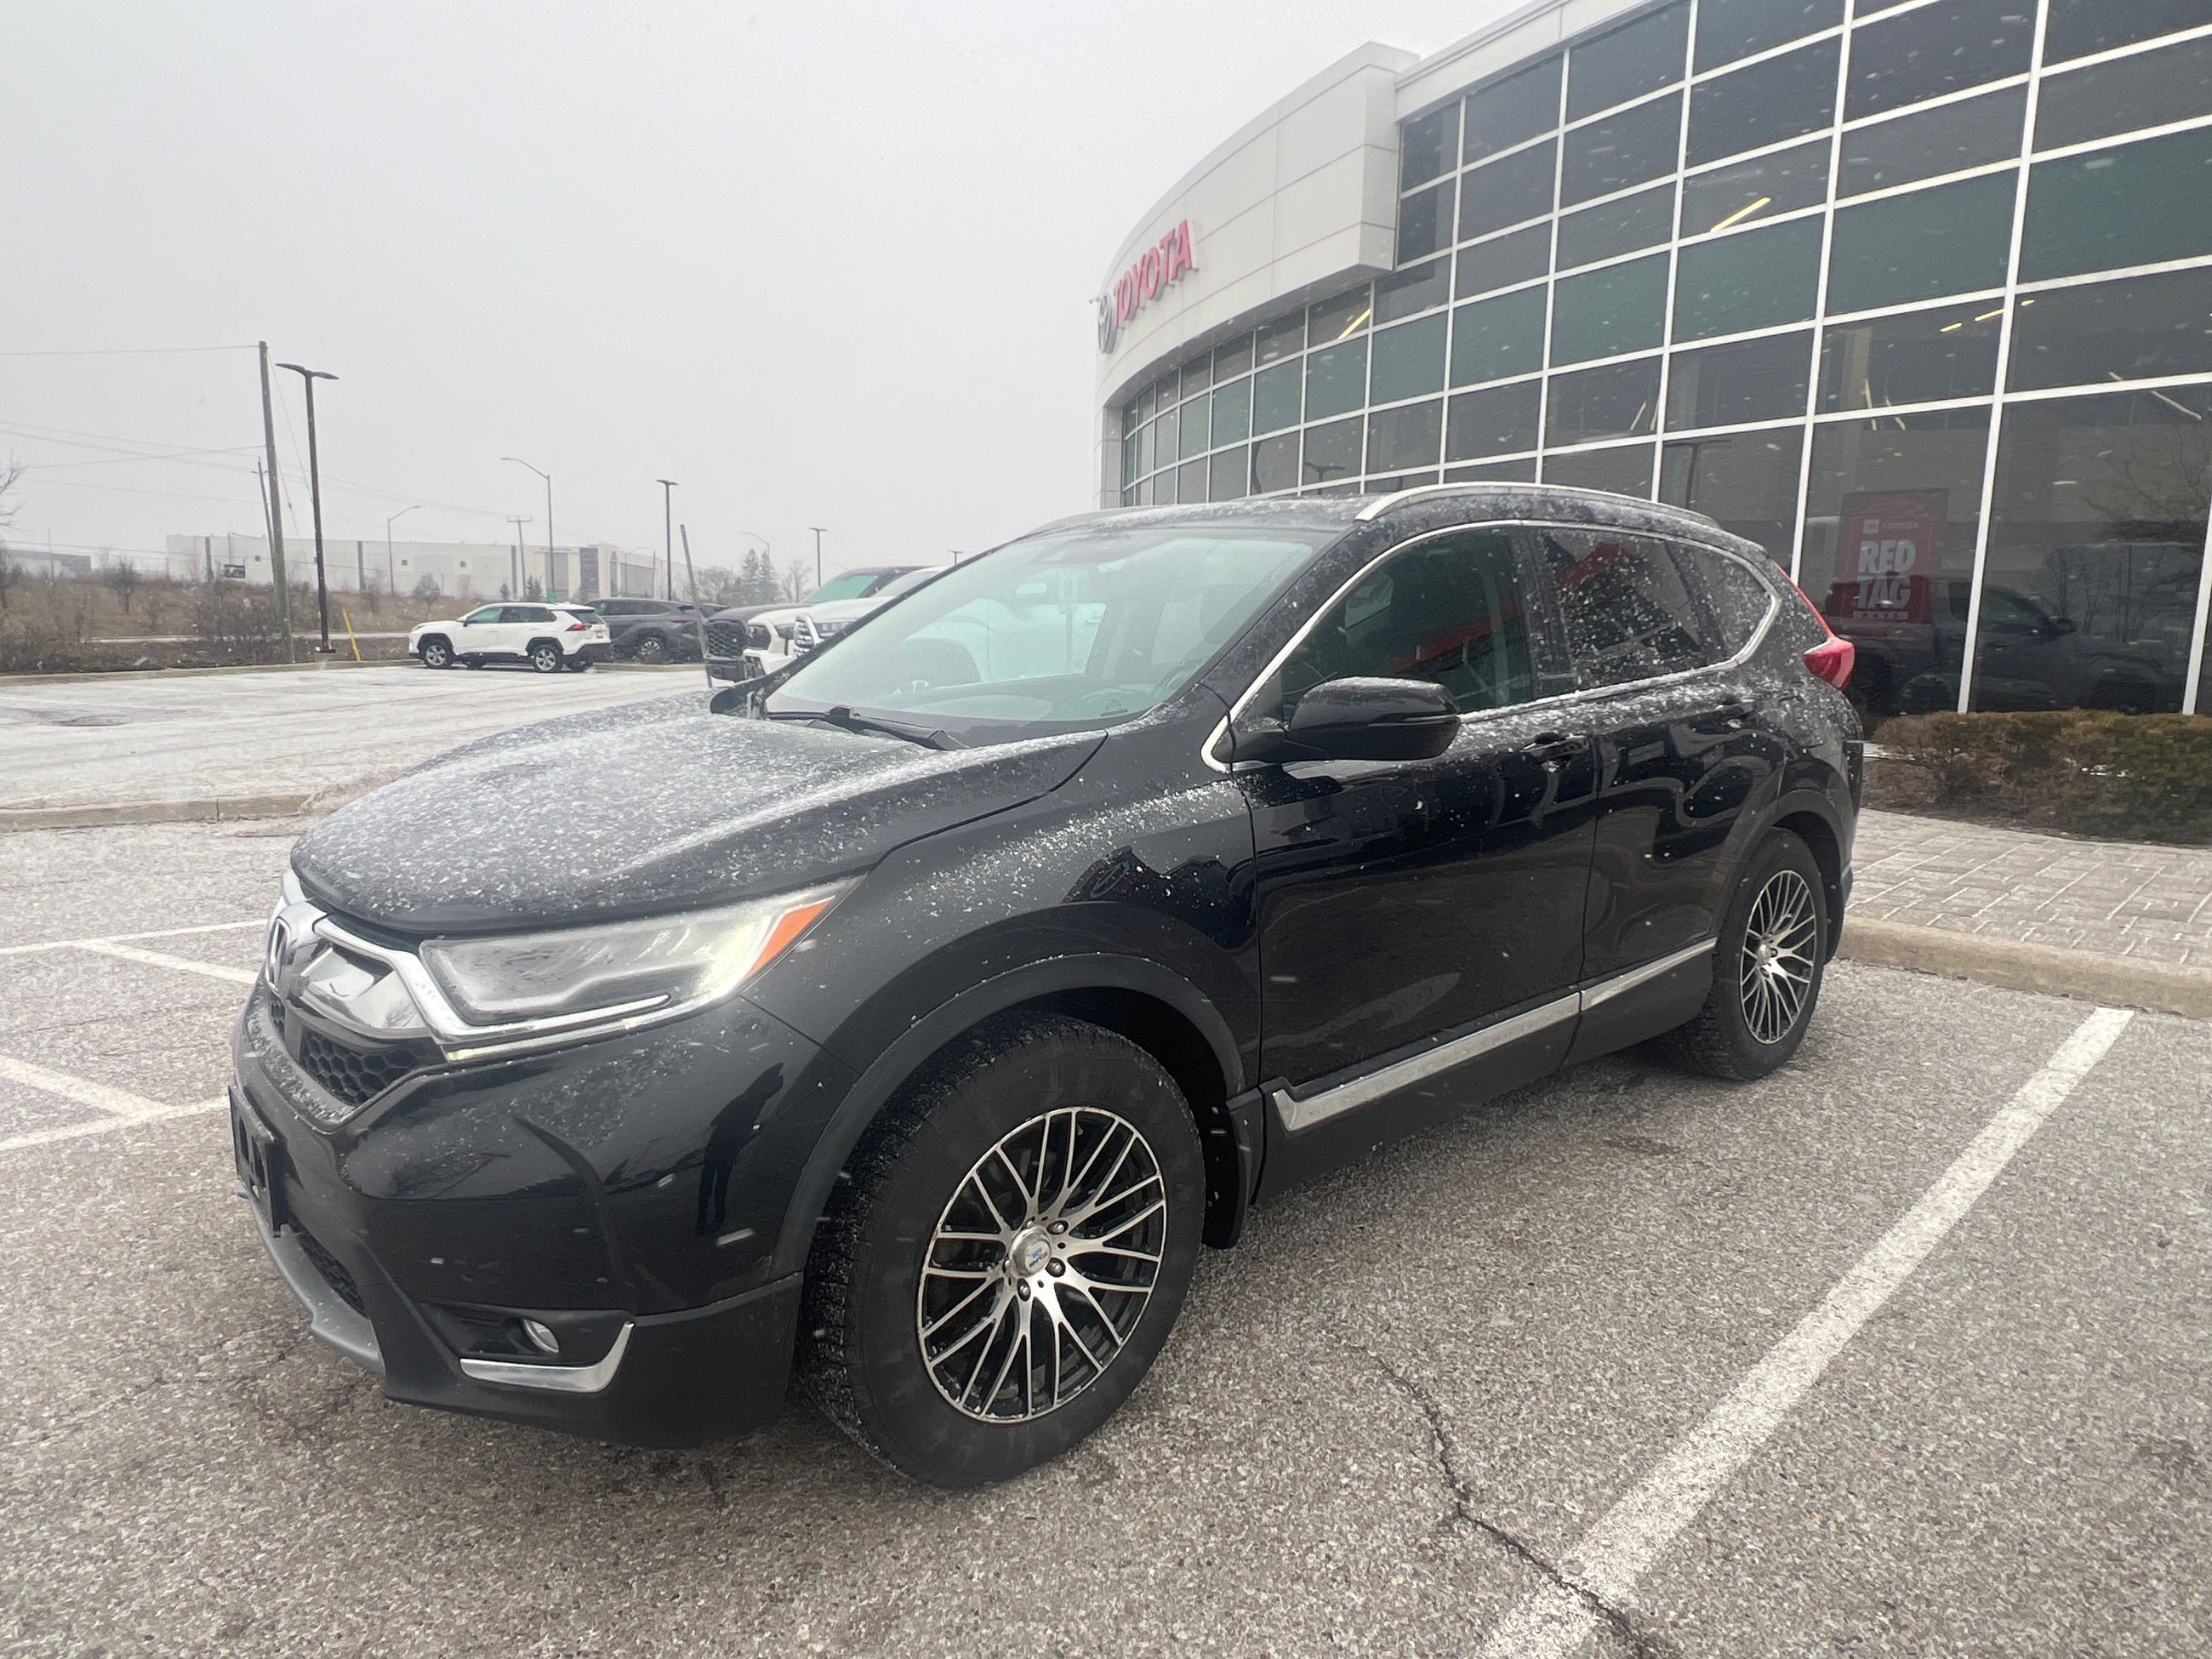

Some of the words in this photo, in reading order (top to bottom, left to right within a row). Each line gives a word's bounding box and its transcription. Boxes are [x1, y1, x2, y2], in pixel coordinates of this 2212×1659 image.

[1114, 219, 1192, 328] TOYOTA
[1883, 522, 1919, 530] TOYOTA
[1858, 539, 1916, 573] RED
[1857, 575, 1911, 609] TAG
